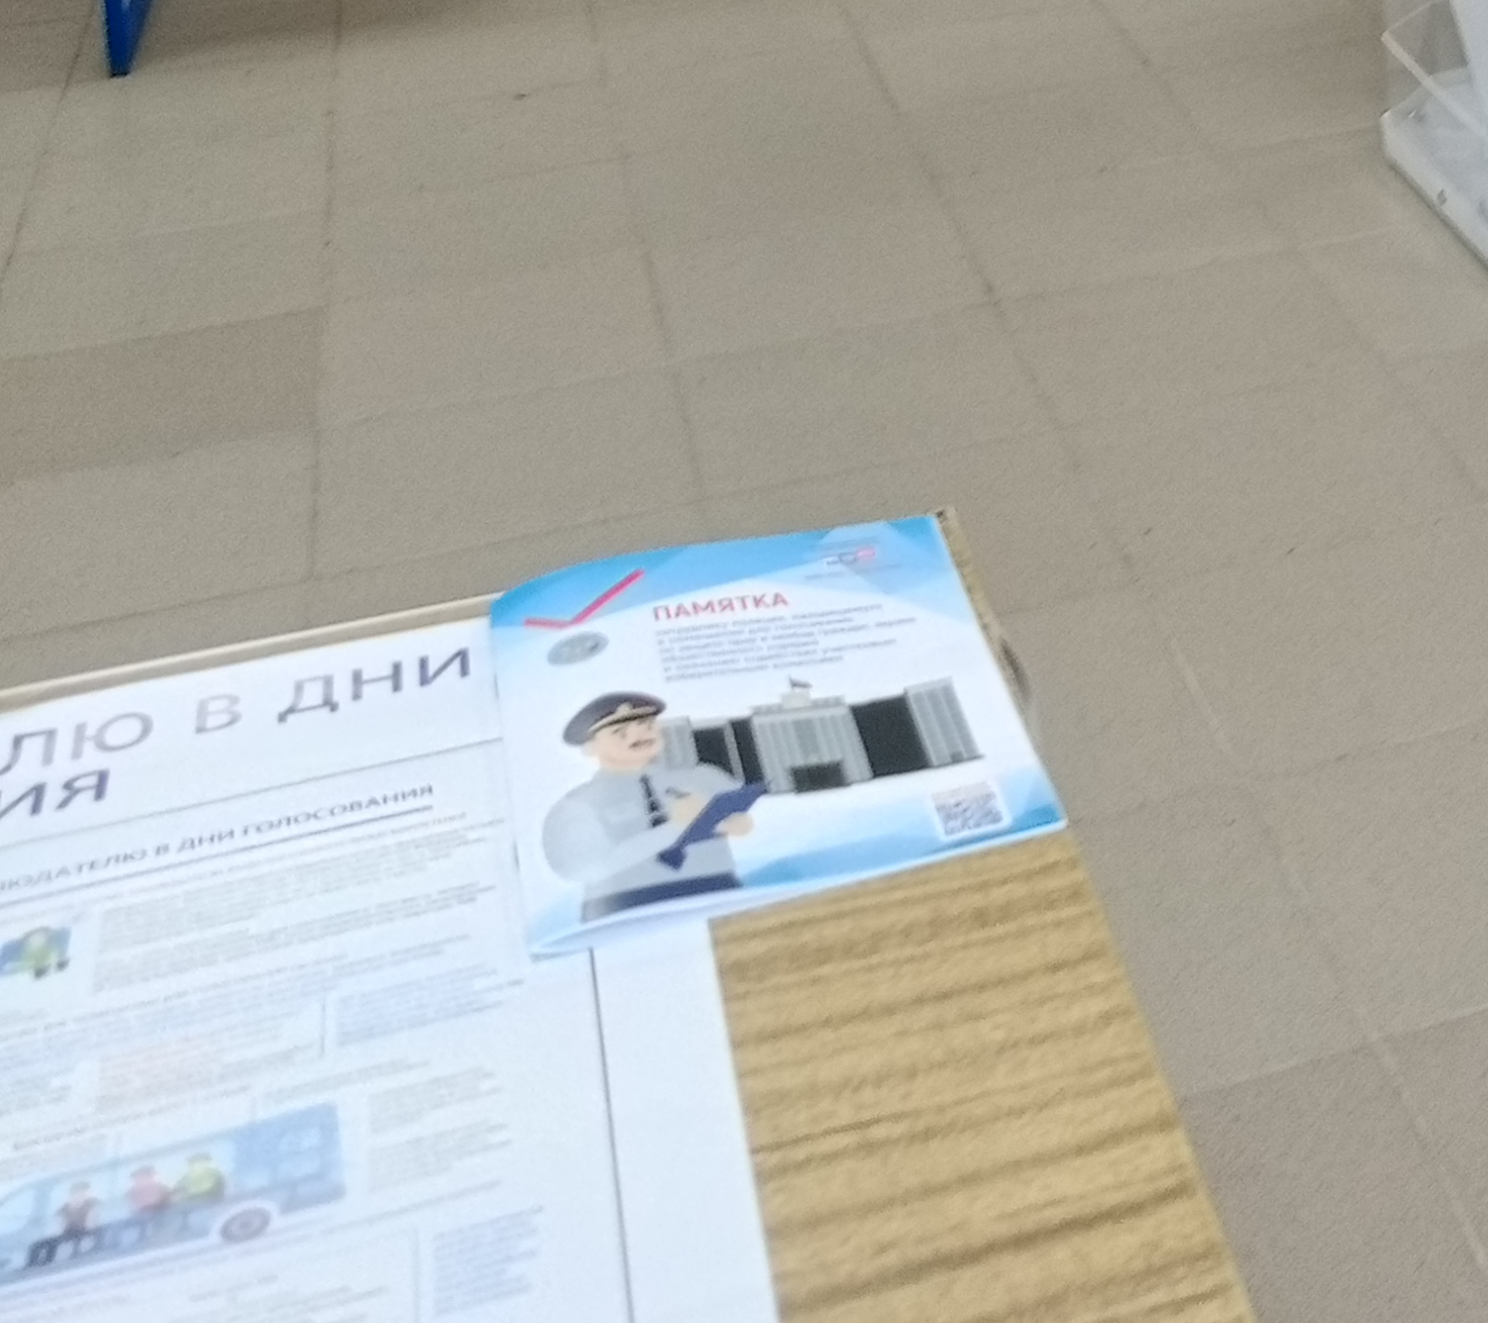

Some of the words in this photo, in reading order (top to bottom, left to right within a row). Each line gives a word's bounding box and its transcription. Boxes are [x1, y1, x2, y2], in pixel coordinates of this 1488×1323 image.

[653, 591, 791, 622] ПАМЯТКА
[194, 693, 242, 735] В
[277, 647, 471, 724] ДНИ
[155, 842, 170, 856] В
[177, 830, 235, 854] ДНИ
[241, 783, 434, 838] ГОЛОСОВАНИЯ
